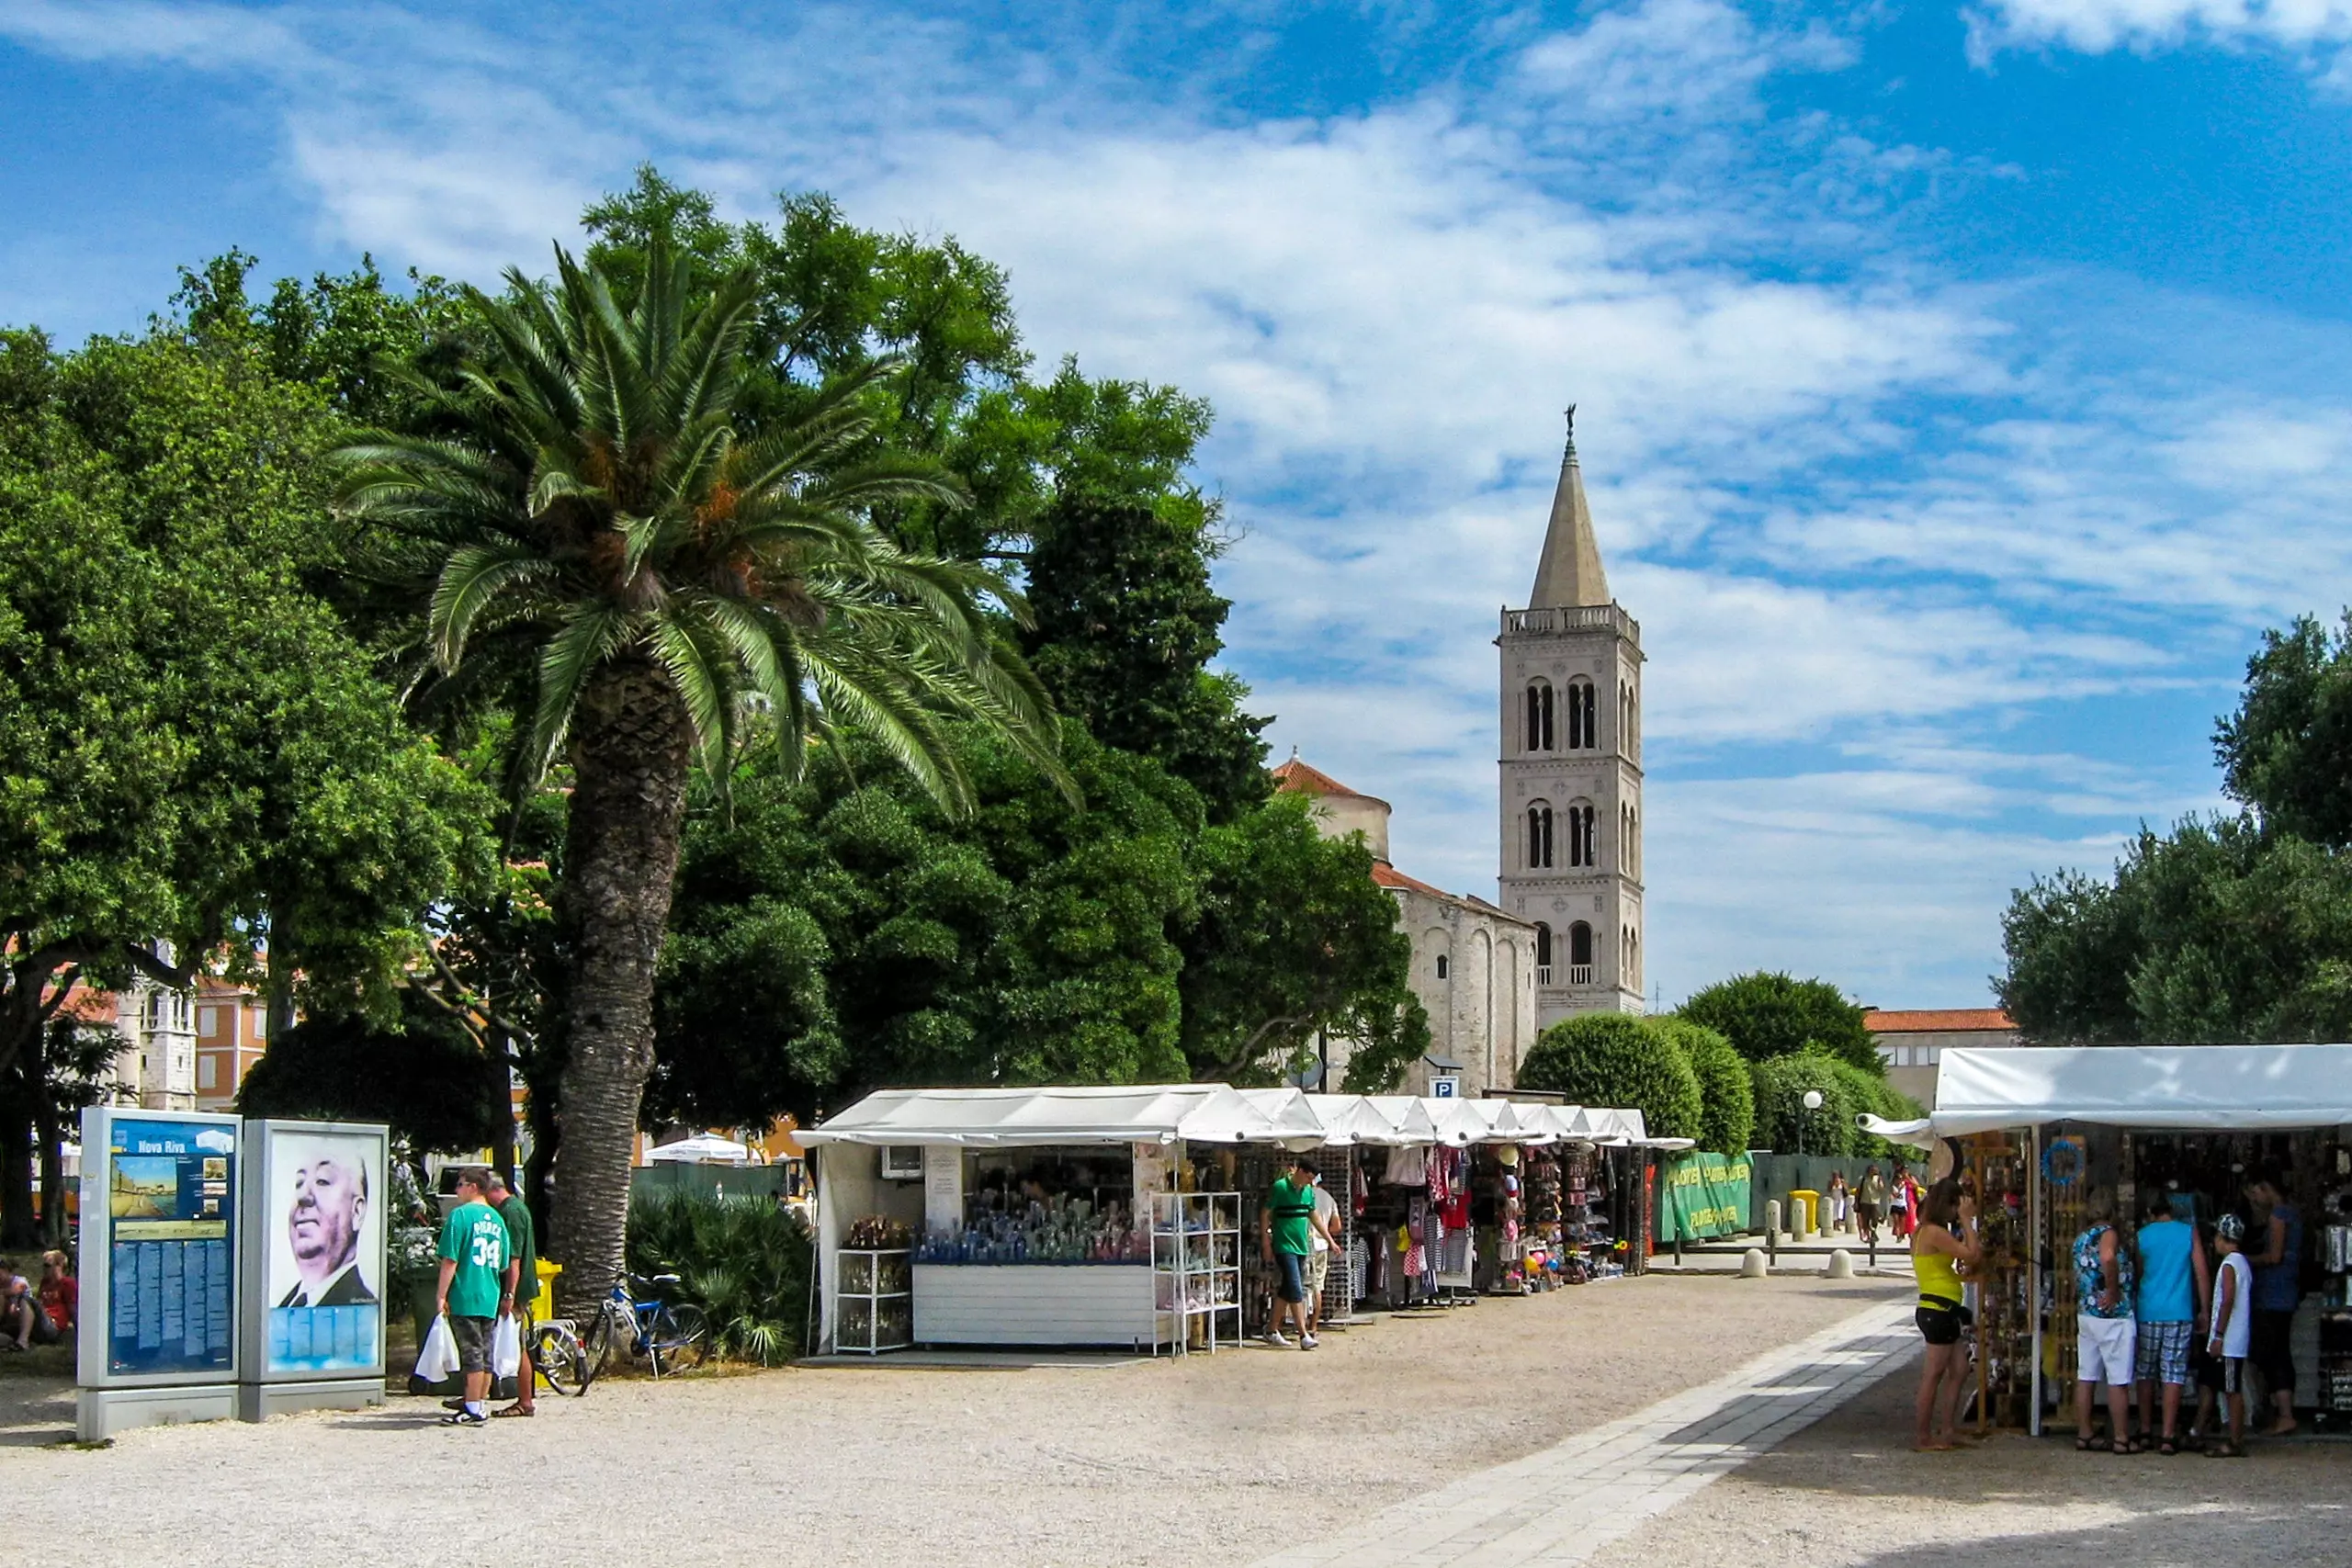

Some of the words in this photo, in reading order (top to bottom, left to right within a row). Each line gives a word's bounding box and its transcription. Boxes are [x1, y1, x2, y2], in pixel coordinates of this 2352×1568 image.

[1439, 1084, 1450, 1097] P
[138, 1139, 163, 1154] Nova
[164, 1140, 187, 1154] Riva
[472, 1236, 501, 1269] 34
